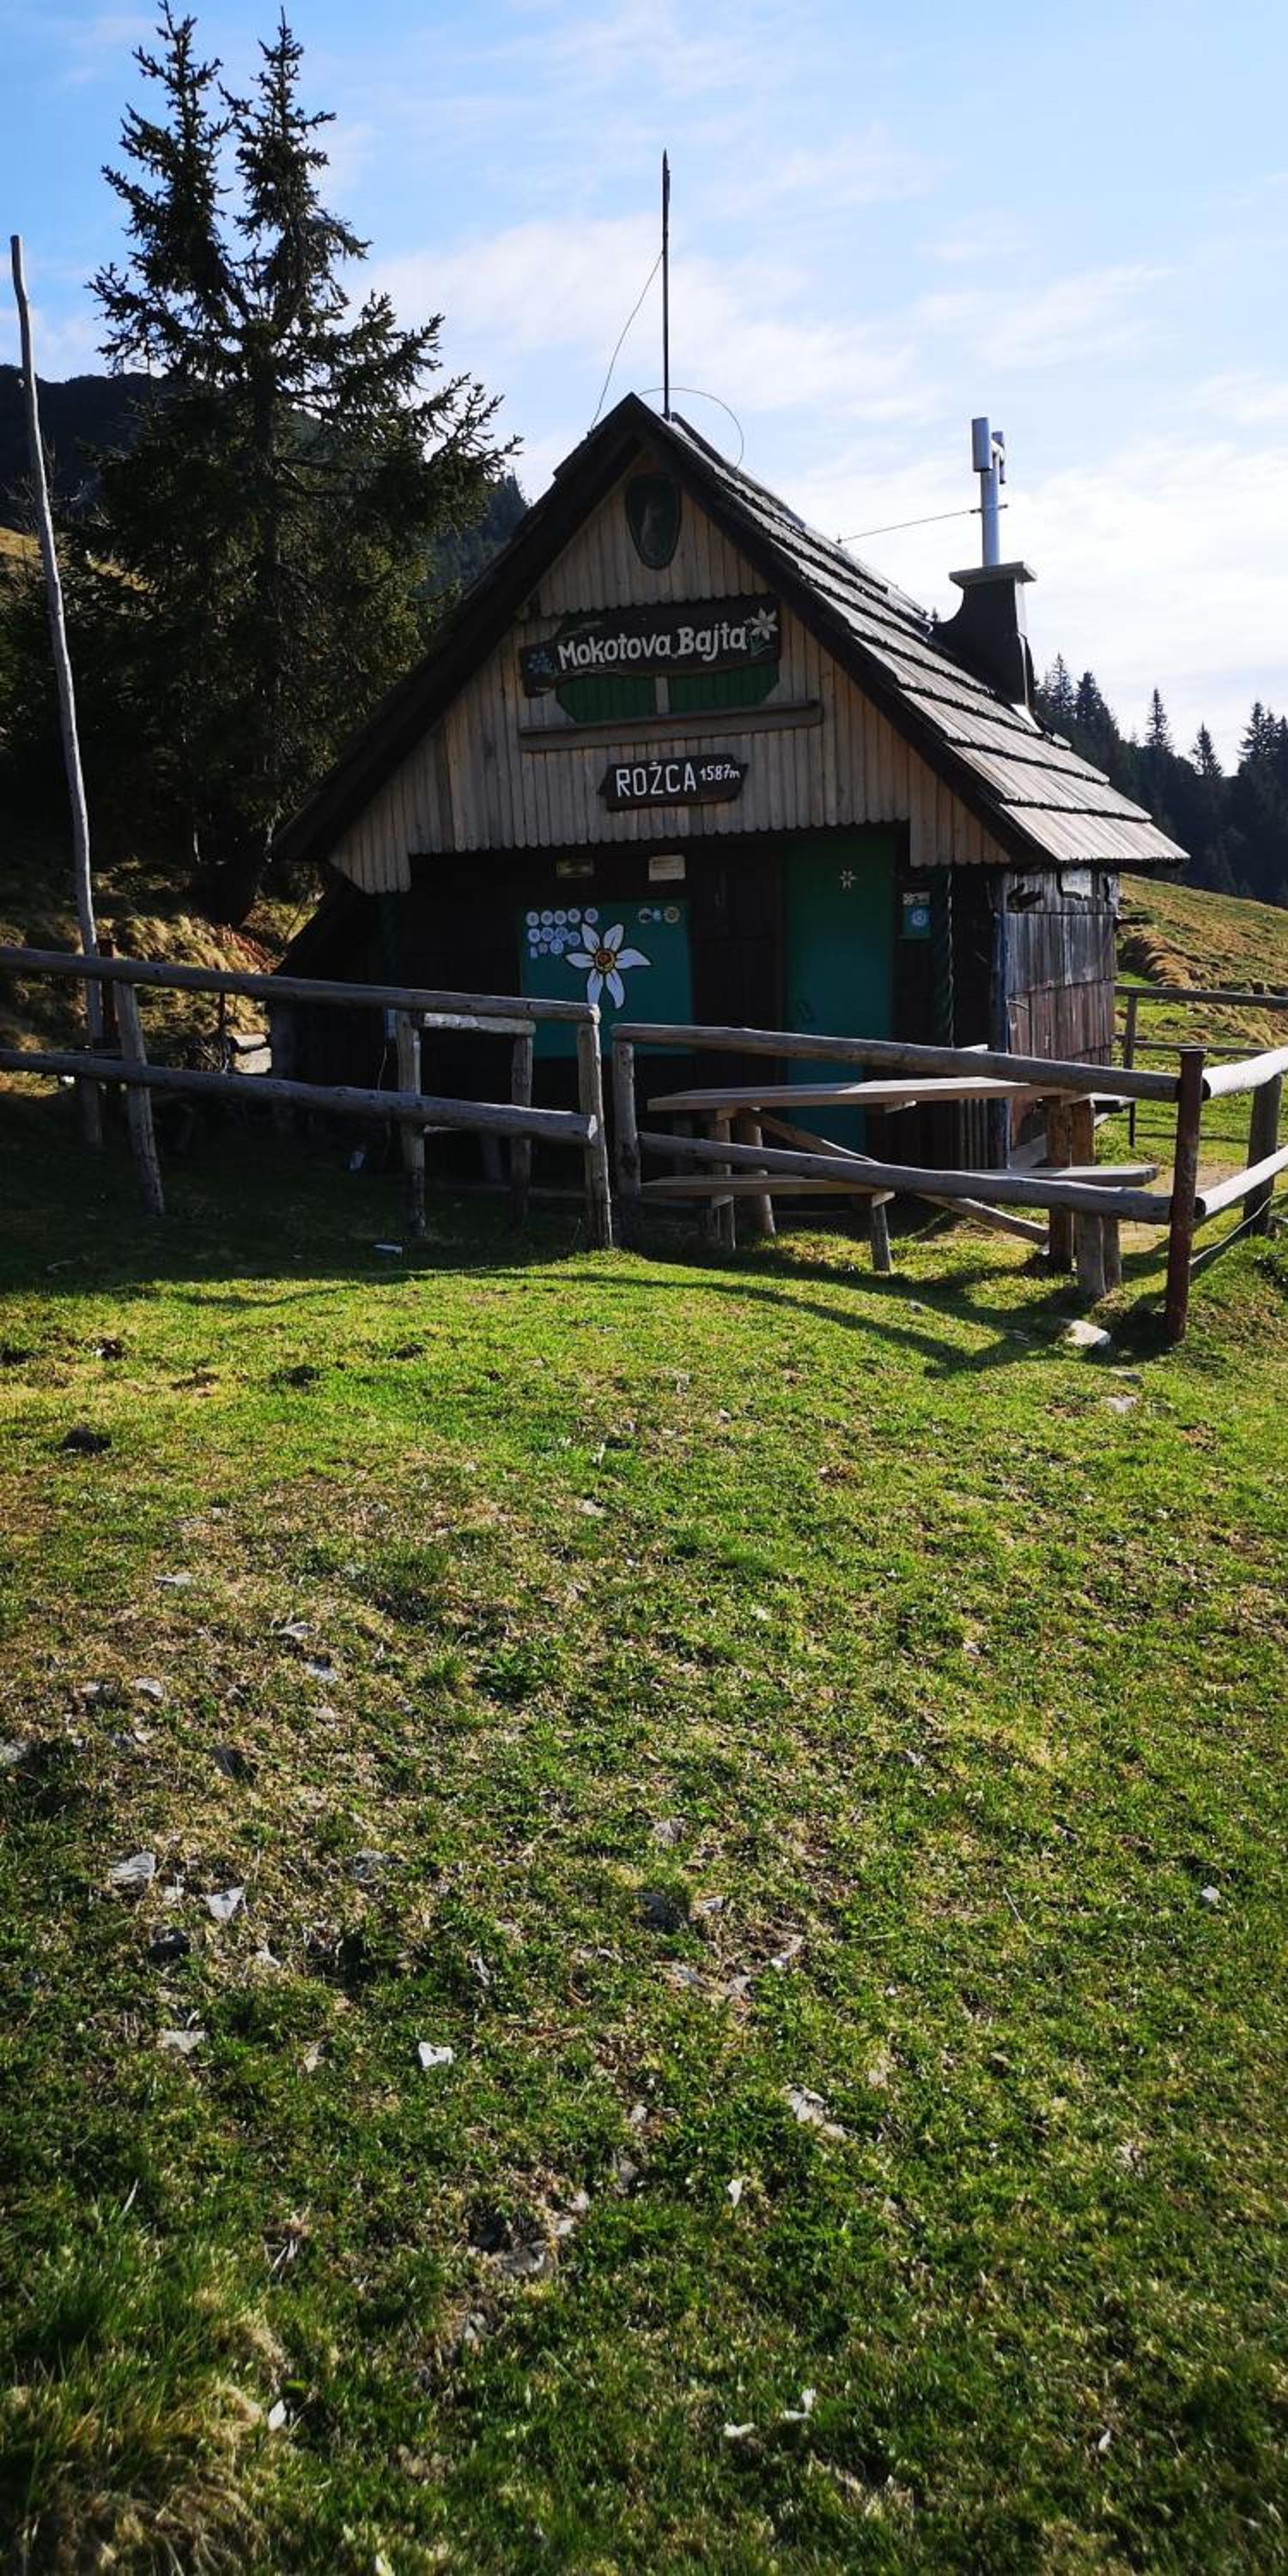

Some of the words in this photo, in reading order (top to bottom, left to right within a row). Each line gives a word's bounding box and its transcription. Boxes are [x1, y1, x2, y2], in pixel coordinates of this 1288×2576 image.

[557, 633, 671, 670] Mokotova
[676, 622, 747, 661] Bajta
[616, 762, 697, 797] ROŽCA
[700, 764, 740, 781] 1587m
